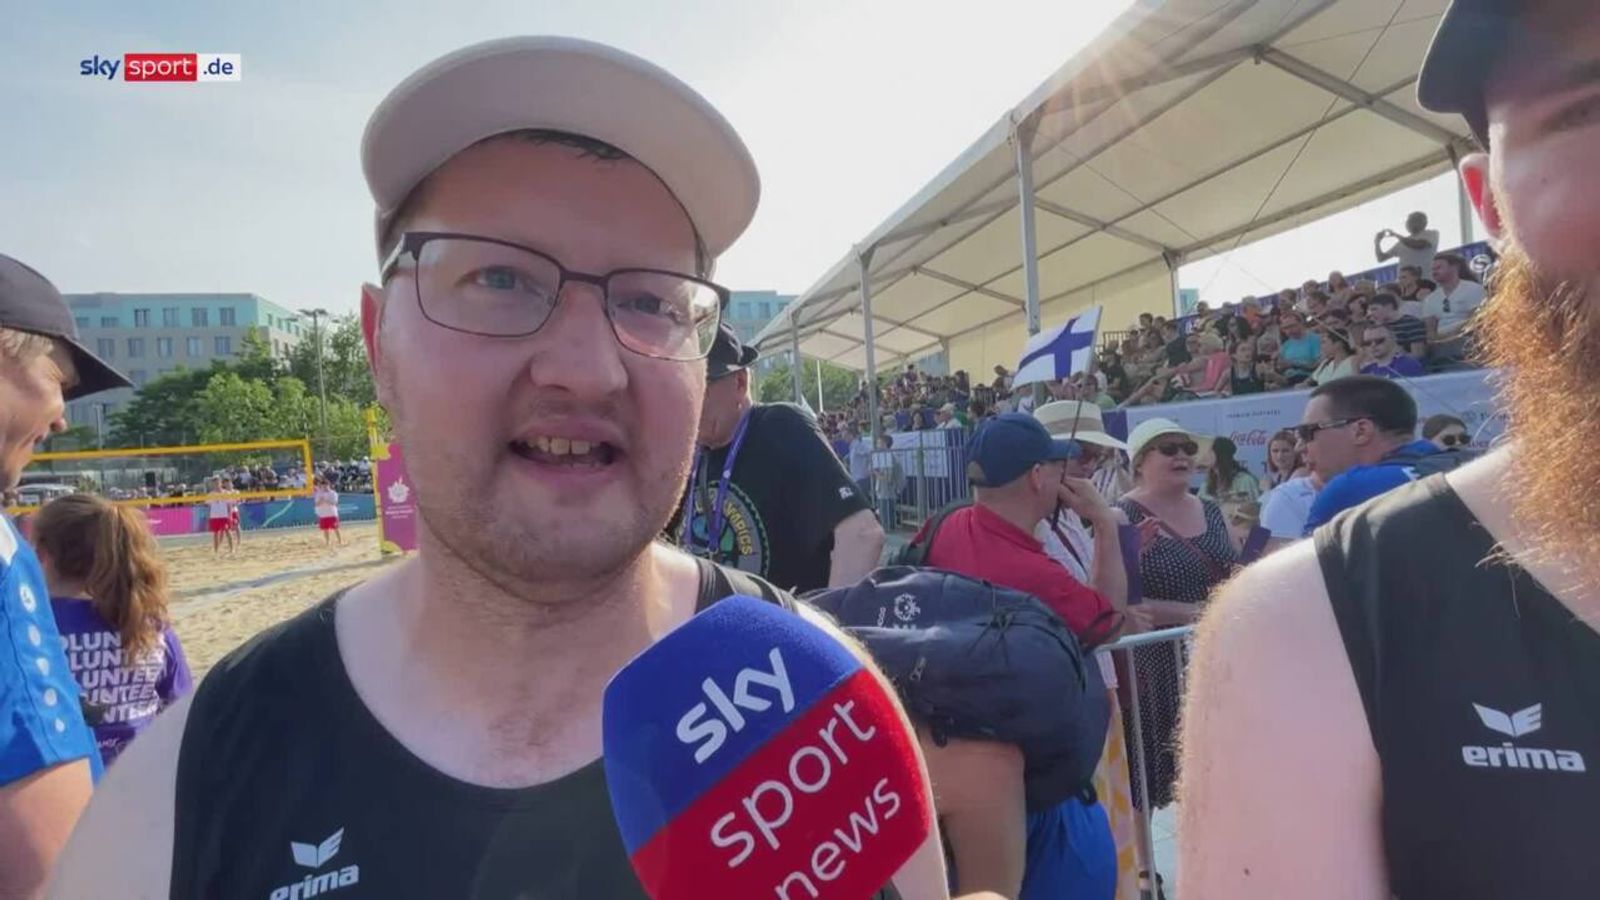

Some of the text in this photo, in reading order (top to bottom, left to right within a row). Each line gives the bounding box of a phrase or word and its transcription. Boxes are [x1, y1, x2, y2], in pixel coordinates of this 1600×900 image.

[676, 647, 795, 764] sky
[1461, 741, 1586, 772] erima
[710, 700, 876, 868] sport
[774, 777, 901, 900] news
[269, 863, 360, 900] erima
